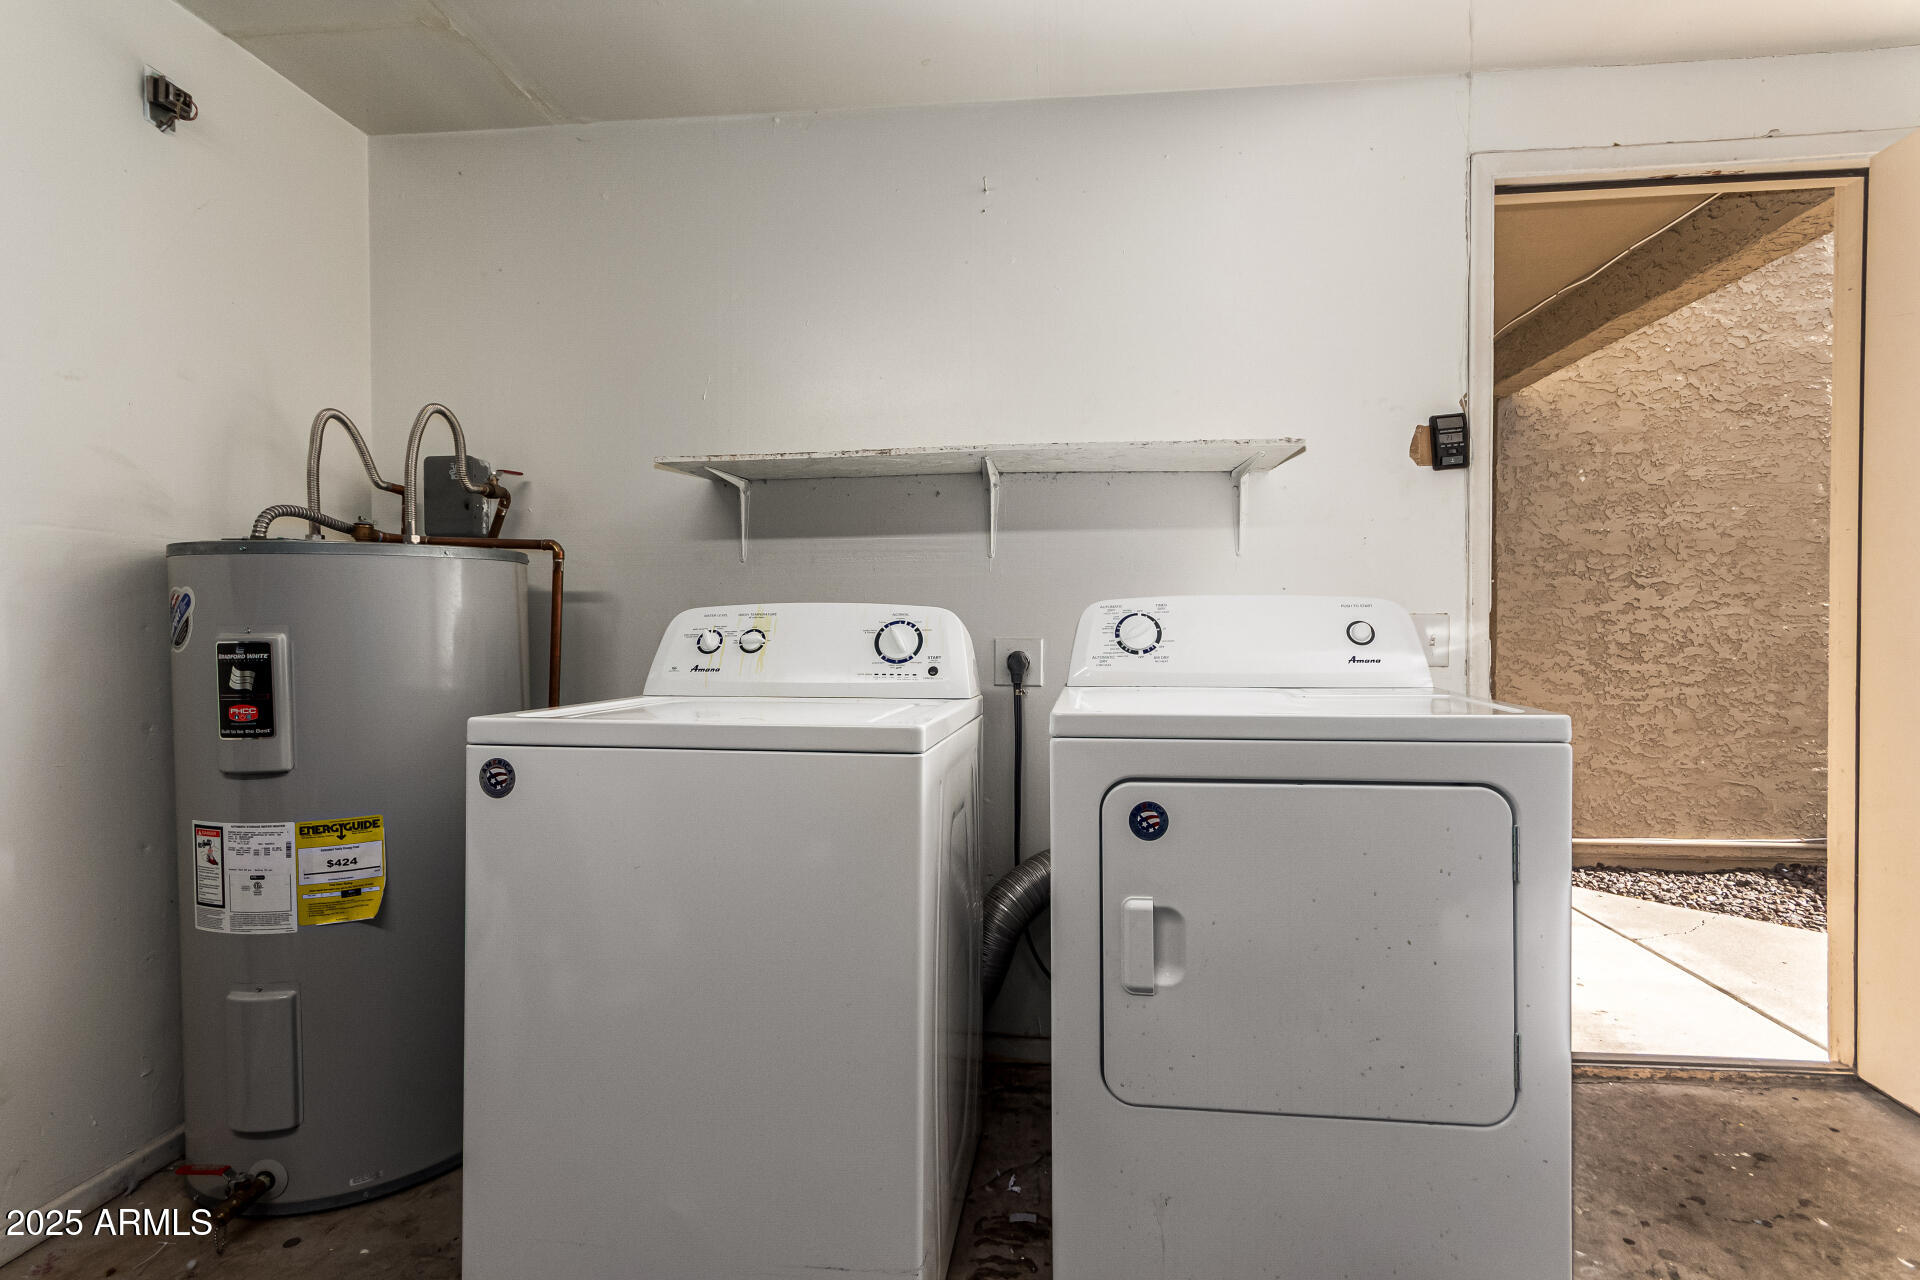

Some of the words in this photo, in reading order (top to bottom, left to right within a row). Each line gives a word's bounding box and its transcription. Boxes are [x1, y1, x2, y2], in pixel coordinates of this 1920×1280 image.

[1348, 655, 1381, 664] Amana
[689, 664, 721, 673] Amana
[481, 759, 514, 775] AMERICA
[327, 857, 358, 868] $424
